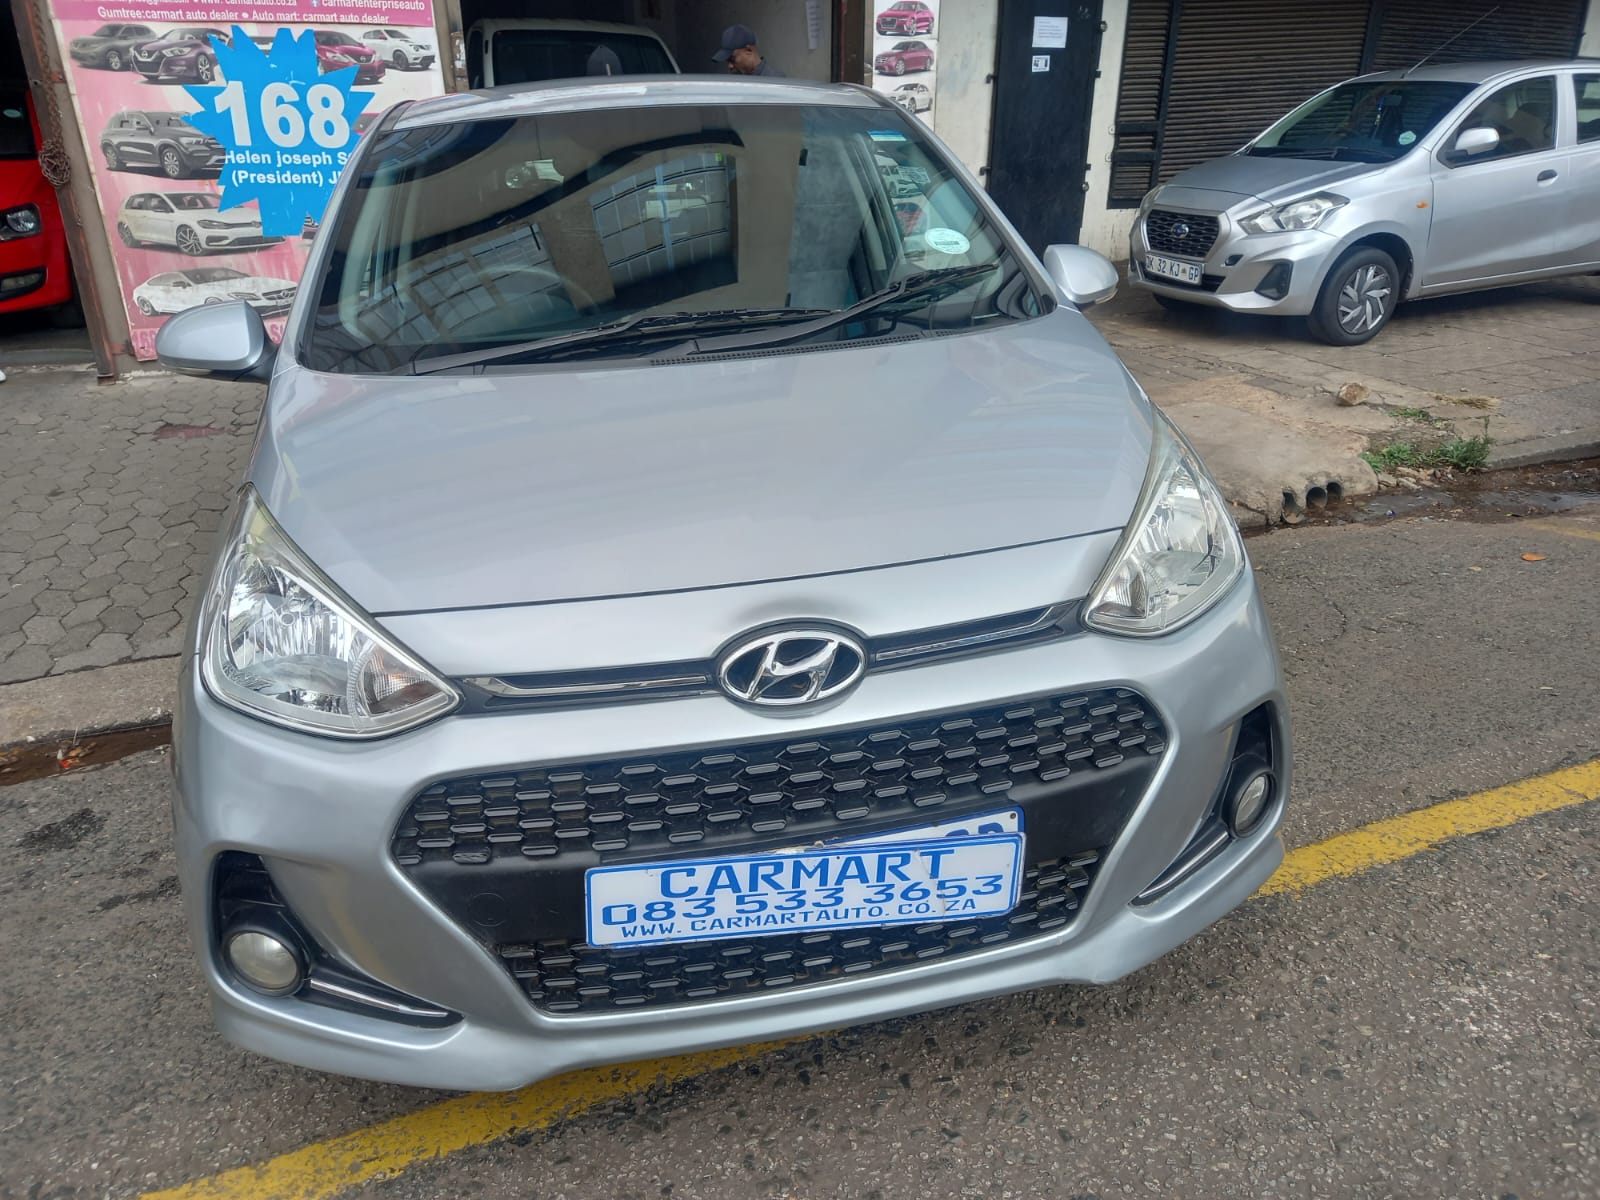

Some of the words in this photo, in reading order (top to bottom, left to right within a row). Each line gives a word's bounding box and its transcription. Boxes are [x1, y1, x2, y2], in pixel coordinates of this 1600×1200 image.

[186, 10, 207, 19] auto
[209, 9, 239, 20] dealer
[252, 10, 274, 20] Auto
[302, 13, 338, 22] carmart
[340, 13, 360, 23] auto
[361, 13, 390, 24] dealer
[214, 80, 351, 149] 168
[225, 150, 272, 165] Helen
[276, 151, 333, 168] joseph
[231, 170, 324, 187] (President)
[1157, 258, 1167, 274] 32
[1169, 261, 1180, 277] KJ
[1188, 266, 1199, 281] GP
[660, 849, 955, 899] CARMART
[602, 897, 716, 926] 083
[735, 887, 845, 914] 533
[862, 874, 1004, 904] 3653
